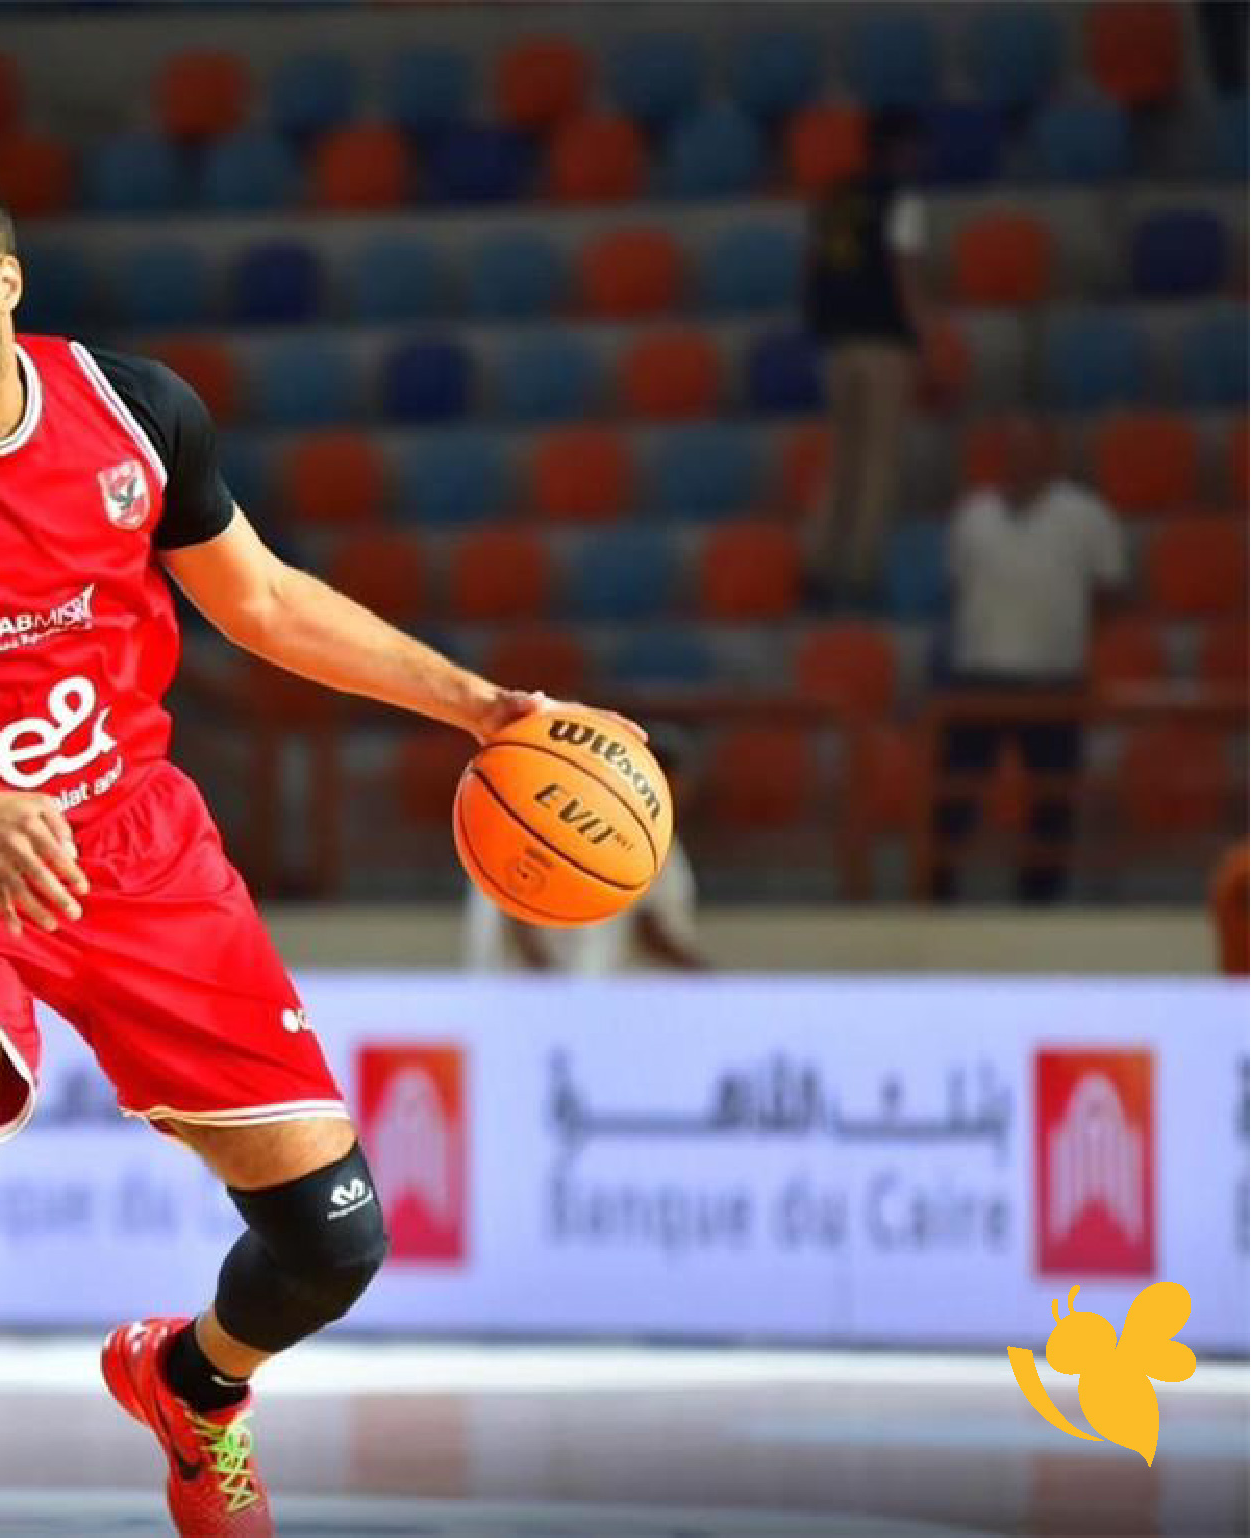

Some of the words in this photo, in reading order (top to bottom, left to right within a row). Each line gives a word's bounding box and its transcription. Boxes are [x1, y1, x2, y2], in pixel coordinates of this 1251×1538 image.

[548, 719, 661, 821] Wilson
[774, 1168, 848, 1256] du
[863, 1168, 1011, 1257] Caire
